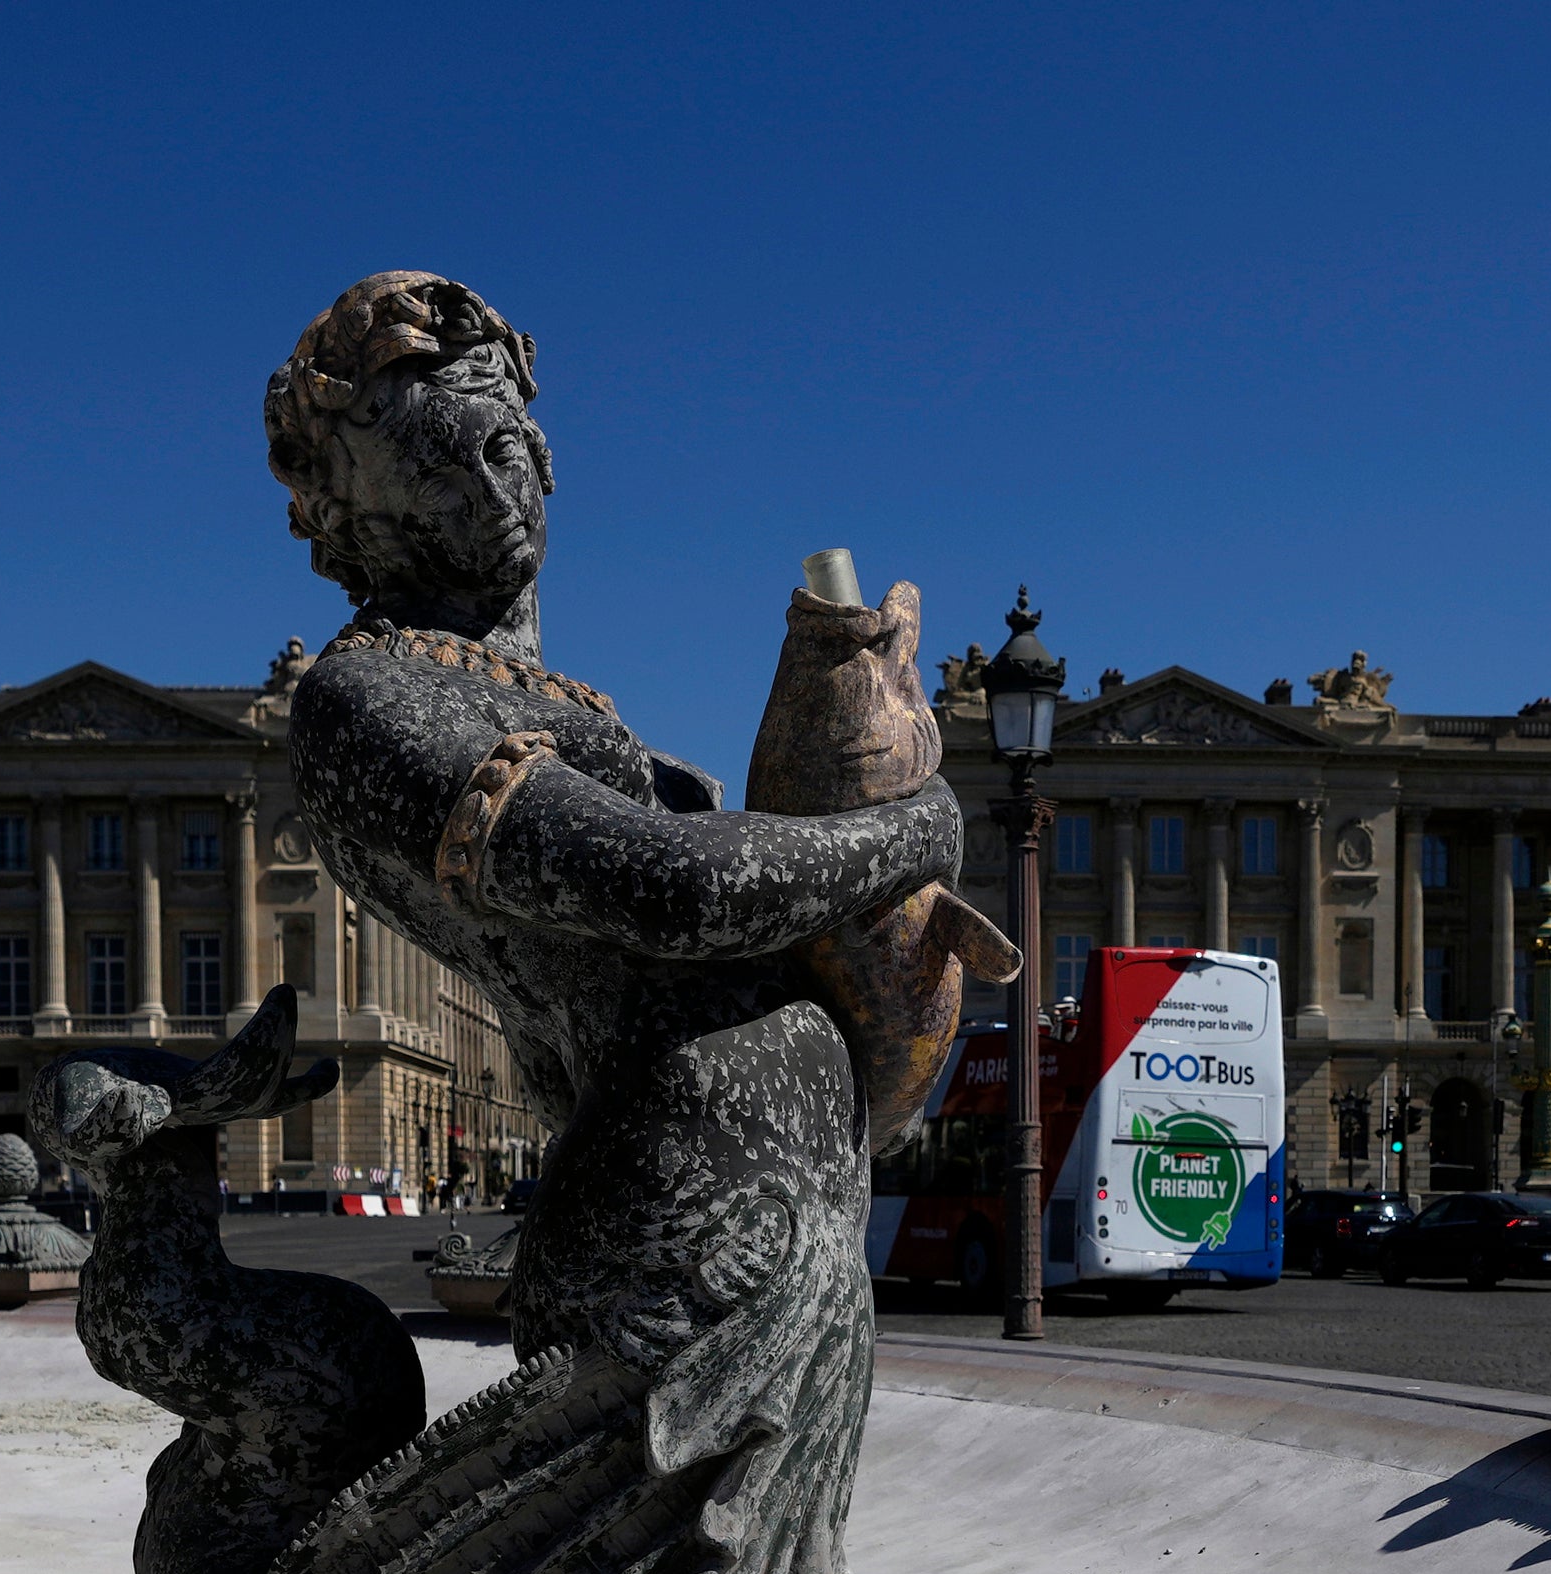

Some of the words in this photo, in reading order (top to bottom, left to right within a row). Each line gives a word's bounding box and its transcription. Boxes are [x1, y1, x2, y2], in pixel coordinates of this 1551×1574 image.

[1156, 999, 1229, 1014] Laissez-vous
[1133, 1015, 1196, 1029] surprendre
[1197, 1021, 1217, 1032] par
[1219, 1019, 1229, 1030] la
[1231, 1020, 1254, 1032] ville
[1159, 1154, 1221, 1175] PLANET
[1150, 1178, 1228, 1199] FRIENDLY
[1115, 1199, 1128, 1215] 70
